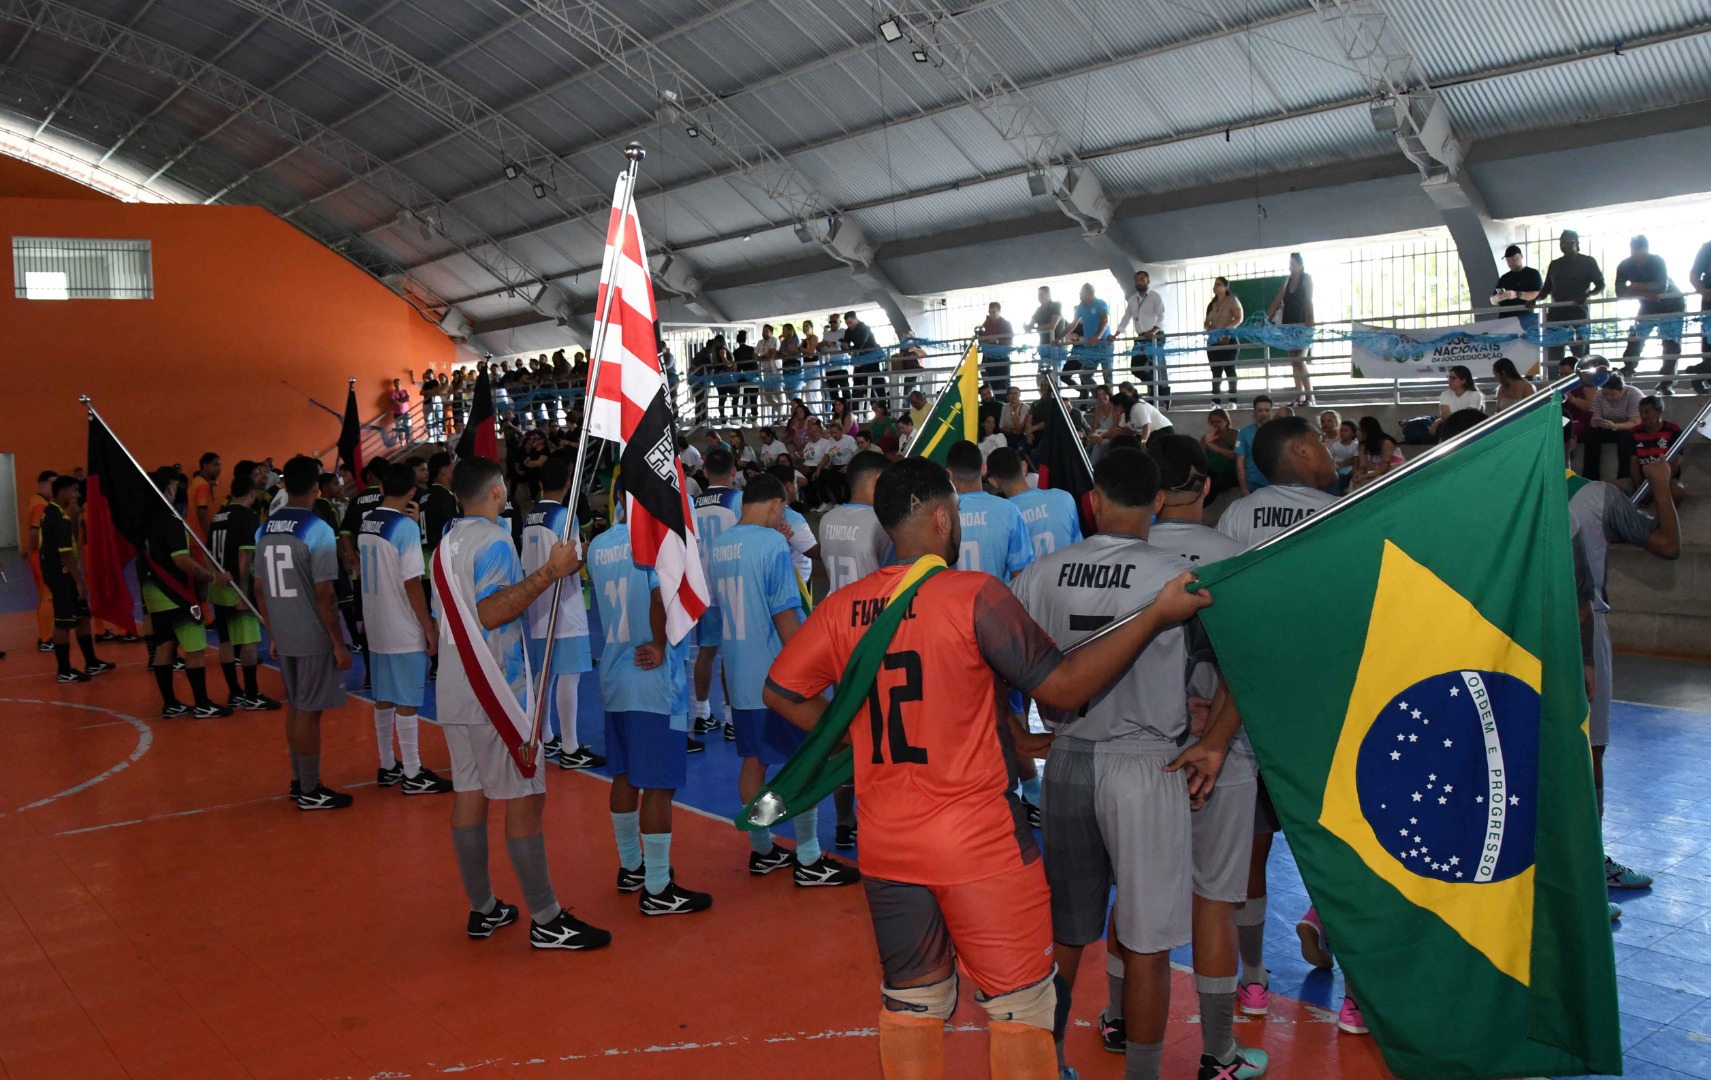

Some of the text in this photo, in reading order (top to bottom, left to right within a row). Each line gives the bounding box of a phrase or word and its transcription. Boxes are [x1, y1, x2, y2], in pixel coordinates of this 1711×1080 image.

[1433, 344, 1501, 356] NACIONAIS
[1441, 352, 1503, 363] SOCIOEDUCAÇÃO
[357, 494, 381, 504] FUNDAC
[695, 493, 722, 507] FUNDAC
[959, 511, 988, 526] NDAC
[1023, 504, 1048, 522] NDAC
[265, 520, 298, 533] FUNDAC
[361, 521, 384, 533] FUNDAC
[825, 525, 860, 541] FUNDAC
[595, 544, 630, 566] FUNDAC
[712, 543, 743, 563] FUNDAC
[263, 544, 298, 597] 12
[360, 544, 378, 595] 11
[1057, 563, 1136, 589] FUNDAC
[867, 650, 928, 764] 12
[1467, 676, 1504, 877] ORDEM E PROGRESSO
